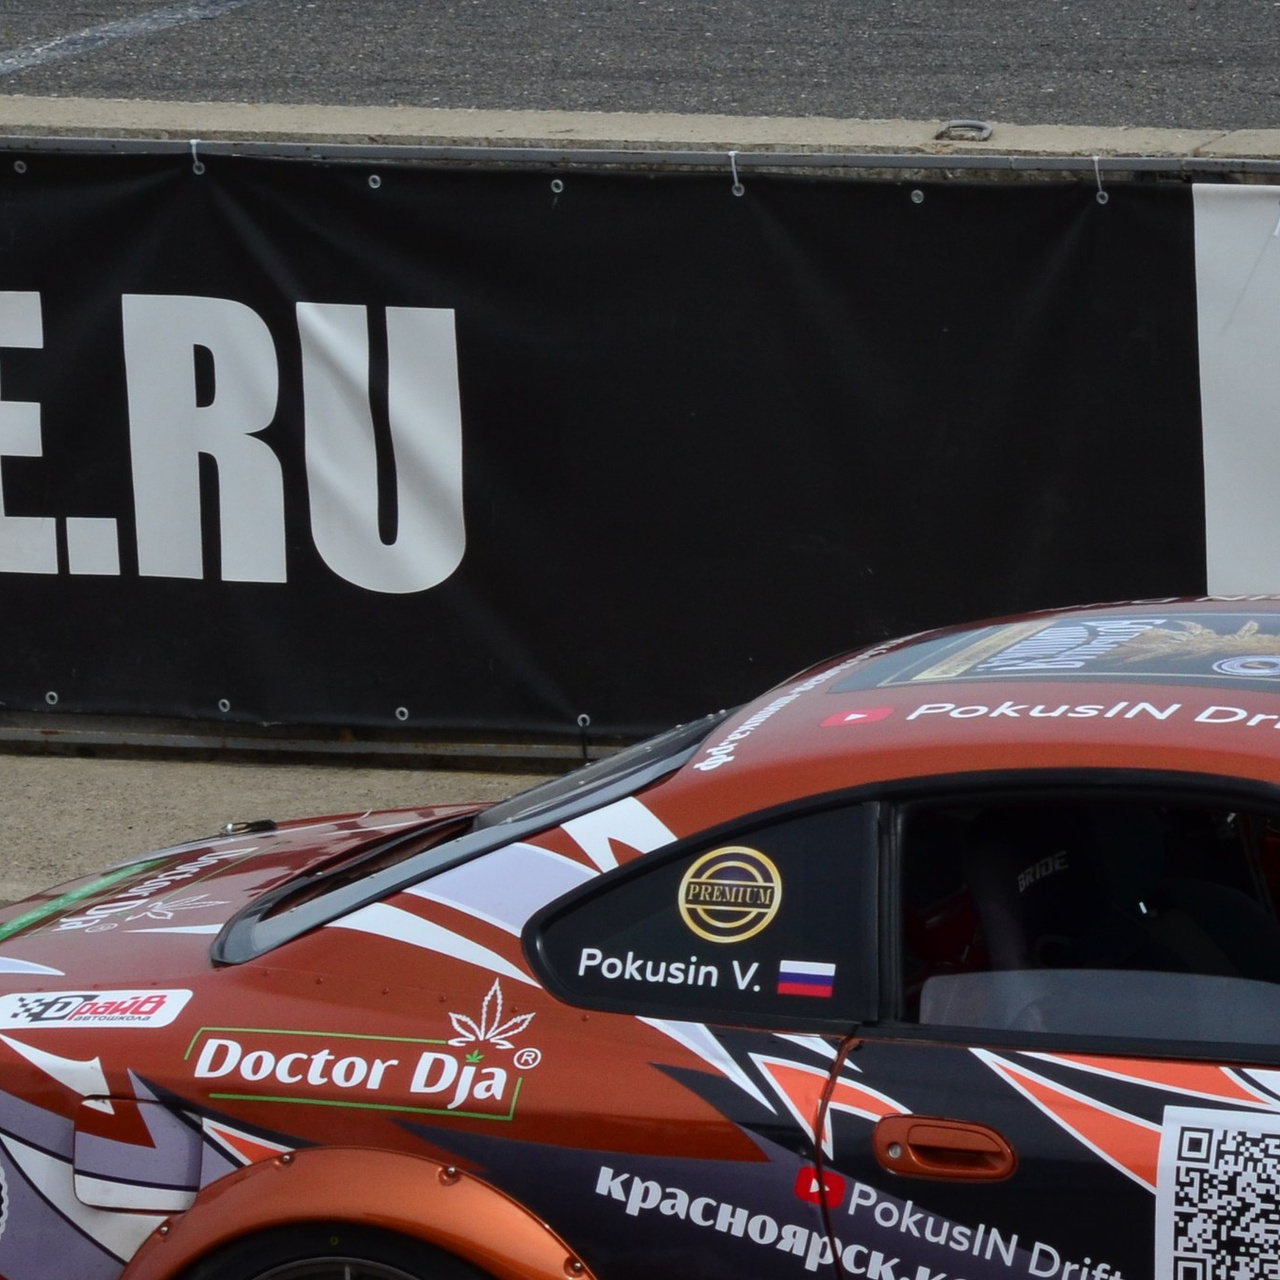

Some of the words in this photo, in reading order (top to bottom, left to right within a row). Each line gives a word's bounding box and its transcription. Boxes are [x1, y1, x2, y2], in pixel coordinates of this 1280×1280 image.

[906, 701, 1181, 721] PokusIN
[1017, 850, 1069, 893] BRIDE
[687, 883, 773, 906] PREMIUM
[578, 947, 718, 988] Pokusin
[732, 960, 761, 992] V.
[194, 1038, 398, 1090] Doctor
[409, 1051, 508, 1110] Dja
[848, 1181, 1019, 1267] PokusIN
